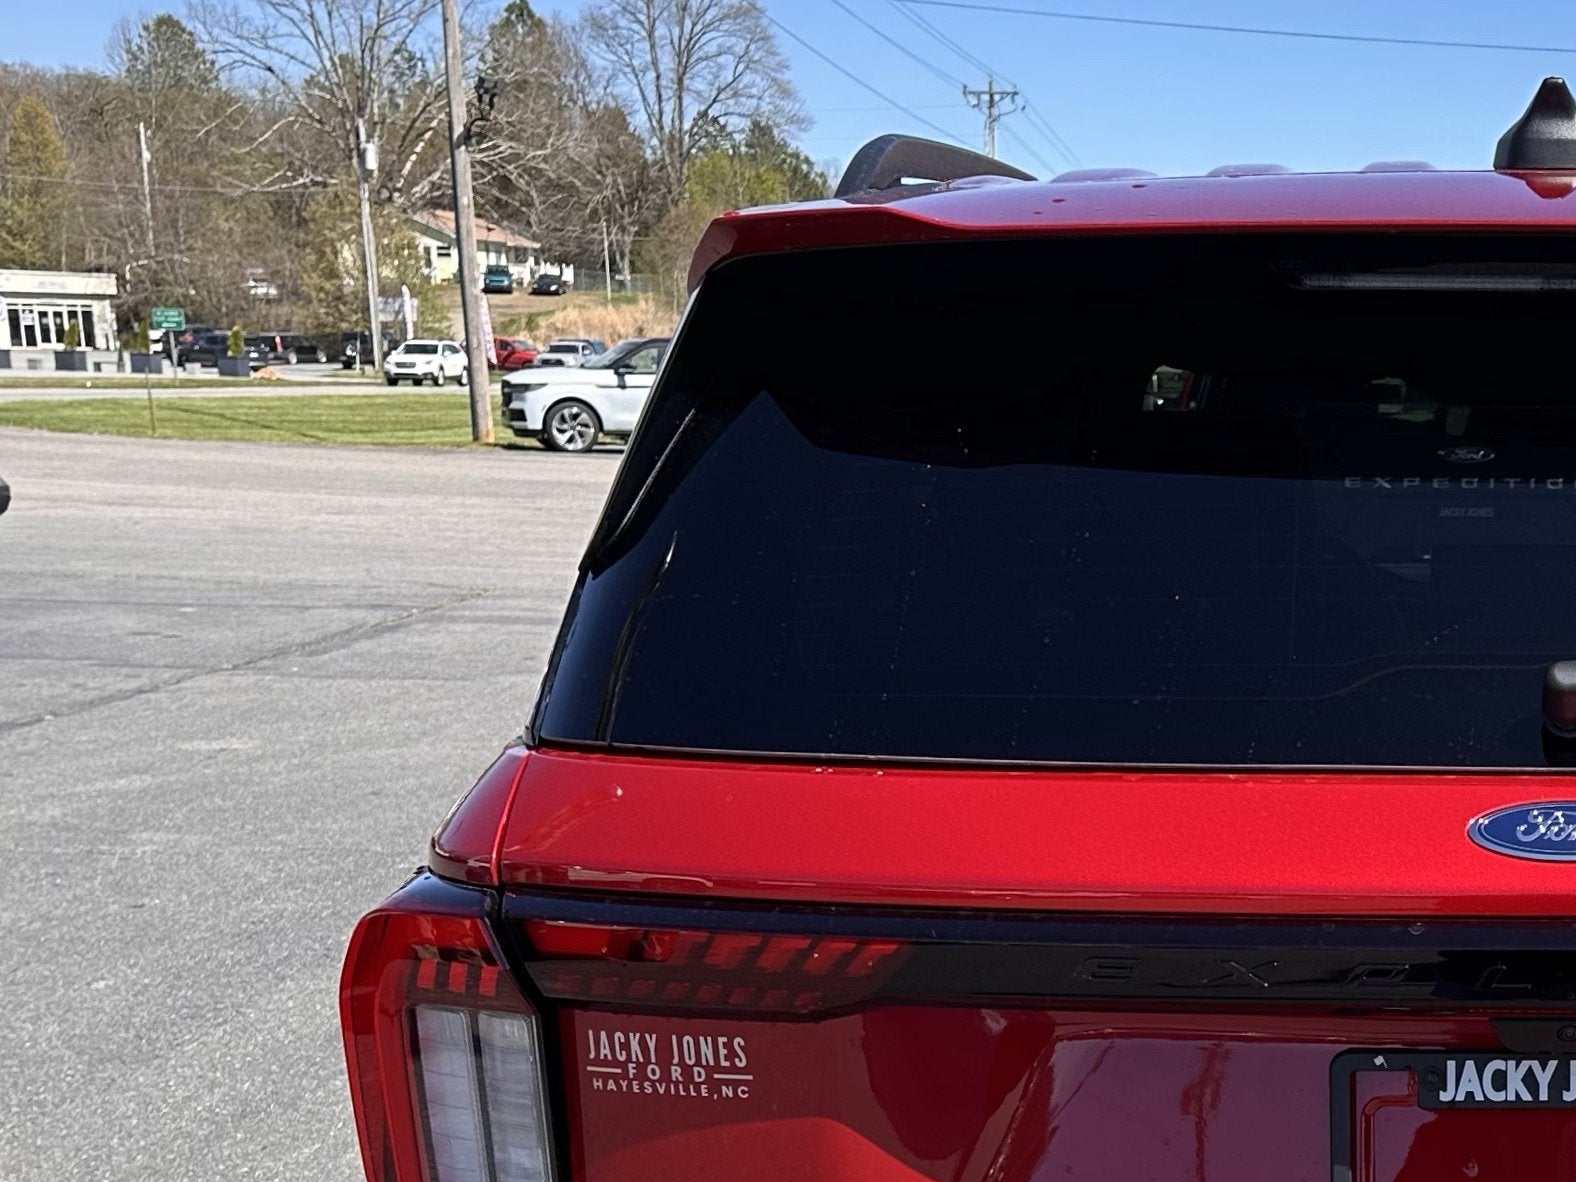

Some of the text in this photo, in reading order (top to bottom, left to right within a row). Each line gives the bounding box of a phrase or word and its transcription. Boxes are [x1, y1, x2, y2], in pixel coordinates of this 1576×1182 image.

[588, 1029, 748, 1068] JACKY JONES
[628, 1063, 707, 1083] FORD
[1438, 1059, 1559, 1102] JACKY
